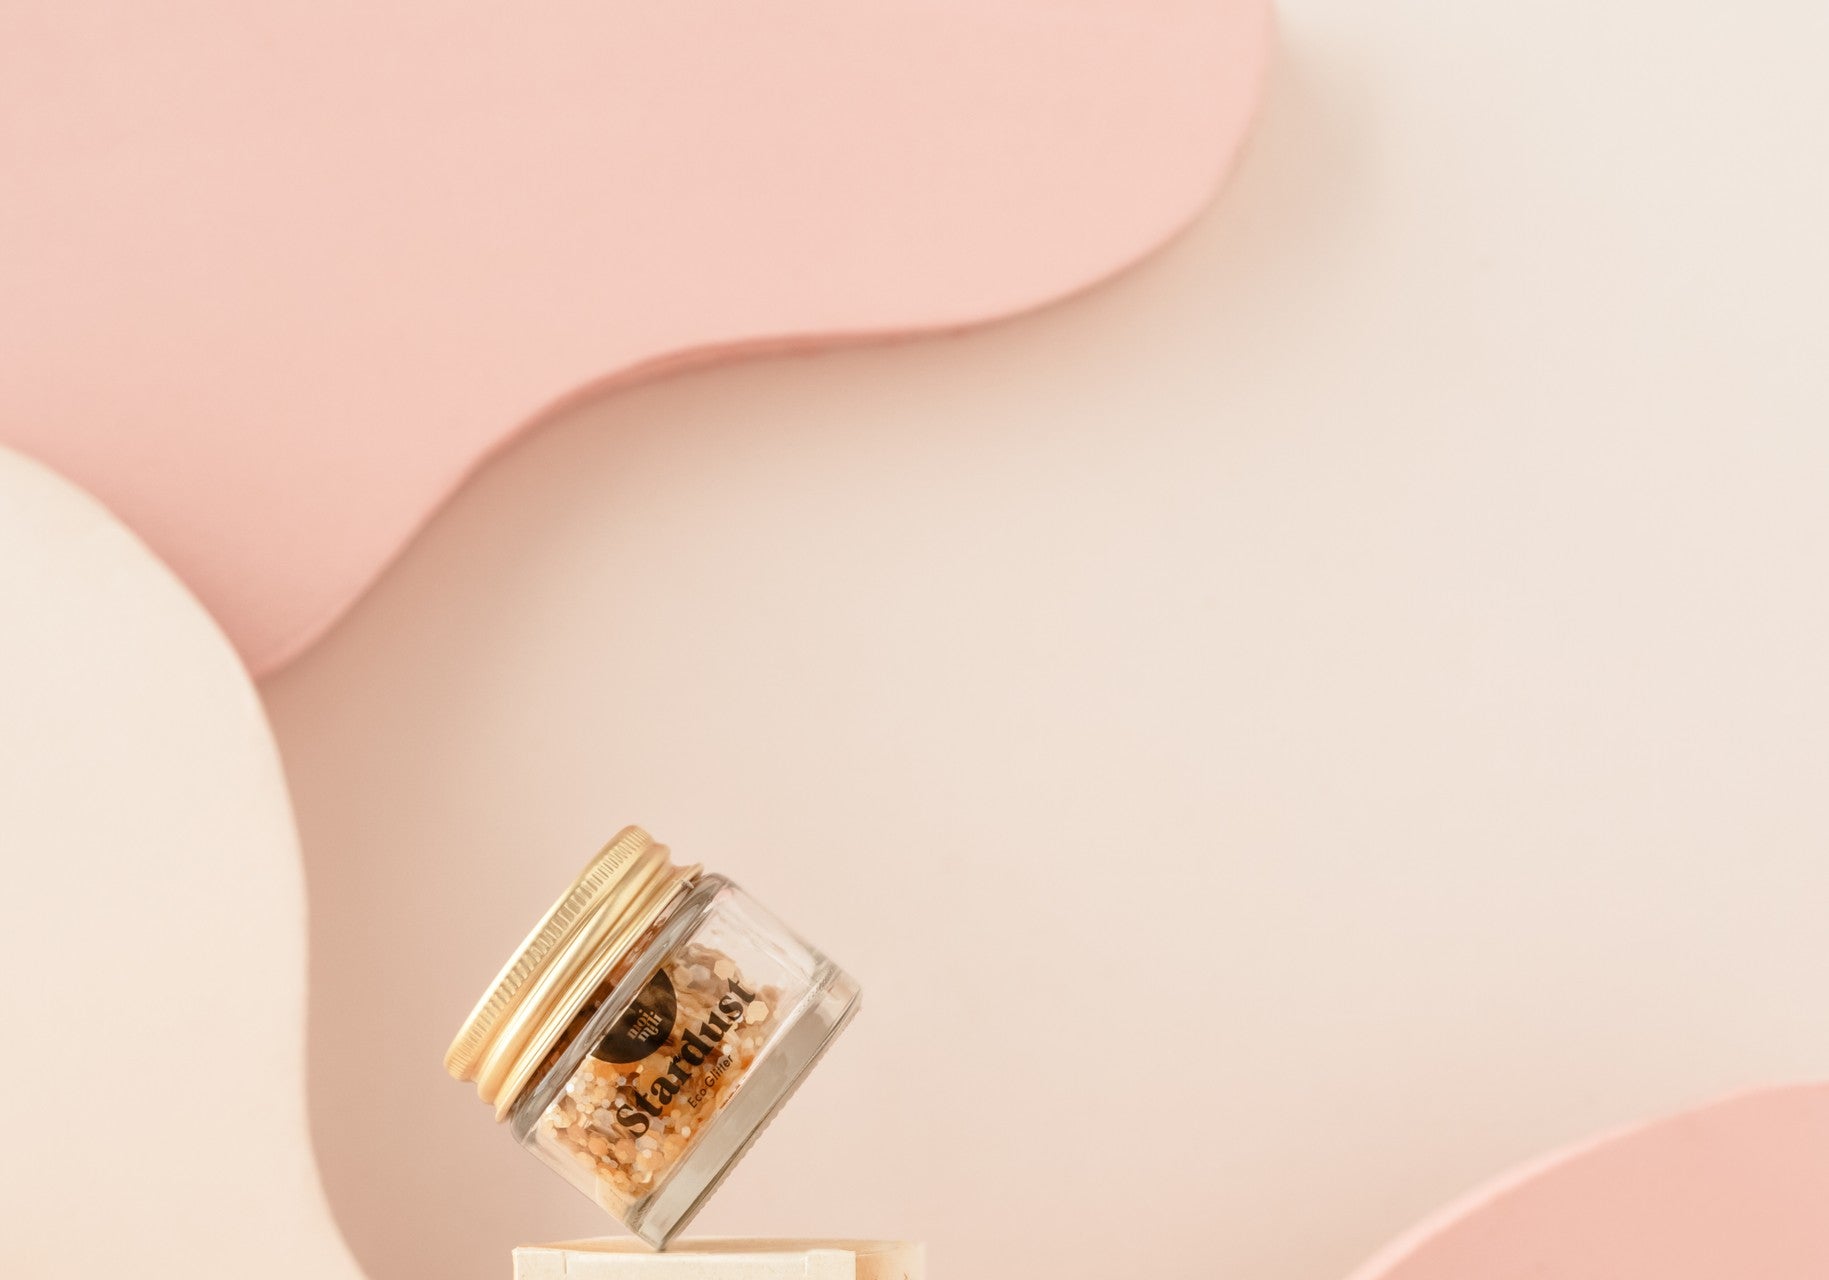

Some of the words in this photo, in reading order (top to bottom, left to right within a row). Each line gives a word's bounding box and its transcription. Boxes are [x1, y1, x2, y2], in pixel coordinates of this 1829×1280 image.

[616, 978, 756, 1138] Stardust
[687, 1089, 707, 1109] Eco
[704, 1054, 734, 1087] Glitter
